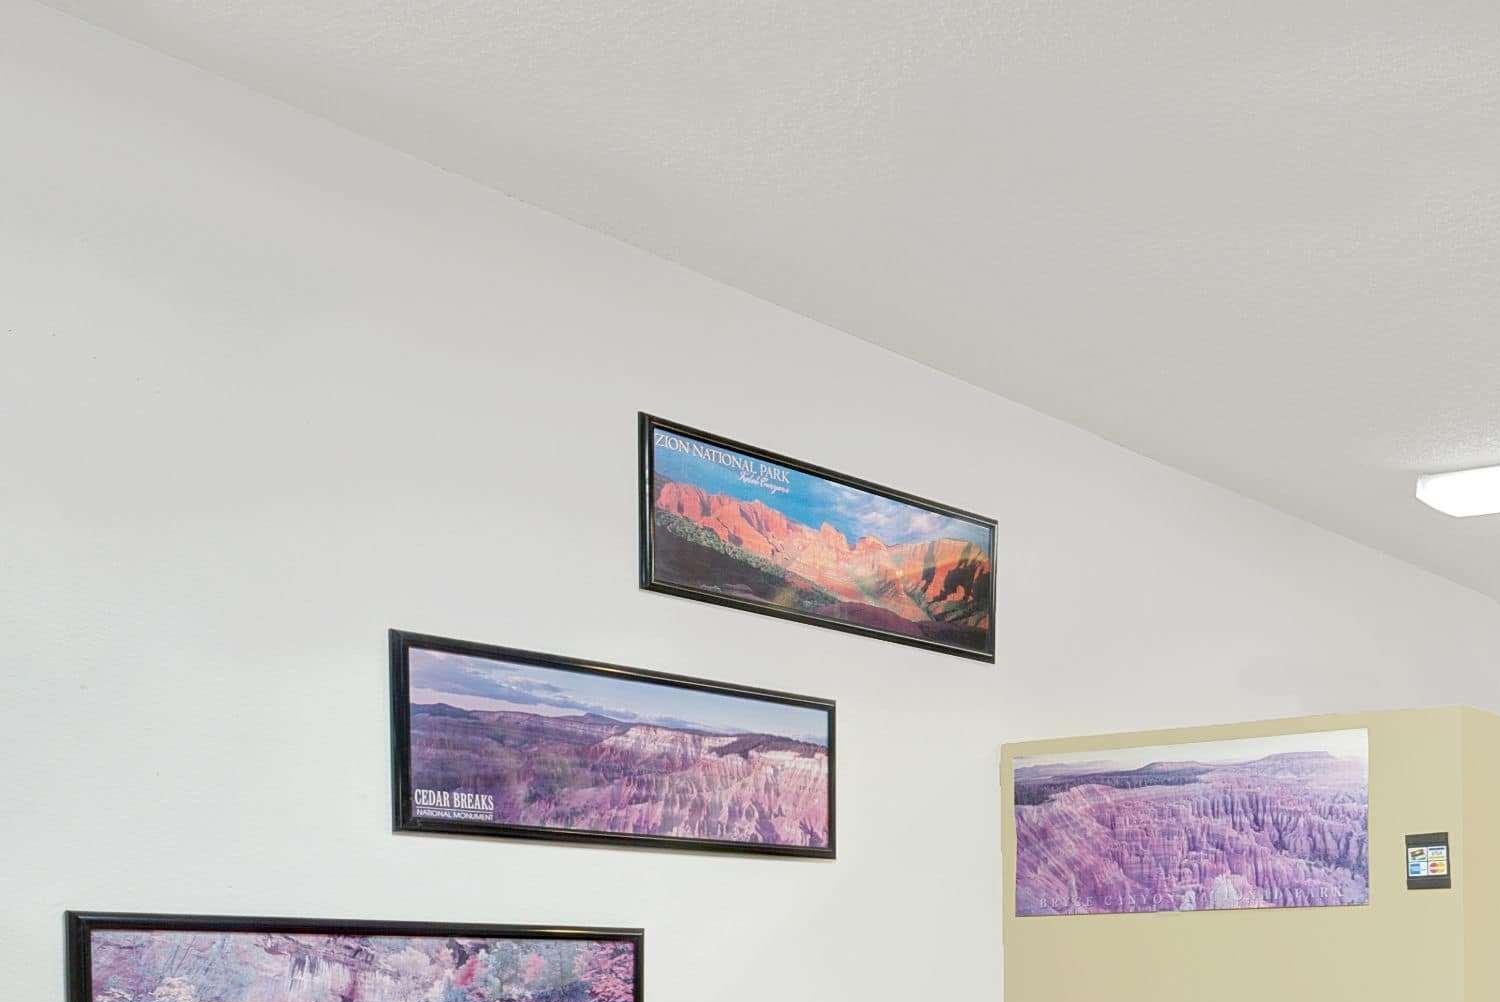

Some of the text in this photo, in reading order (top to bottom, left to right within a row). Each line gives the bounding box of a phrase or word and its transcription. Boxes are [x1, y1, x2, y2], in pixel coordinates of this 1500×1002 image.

[655, 433, 790, 484] ZION NATIONAL PARK
[414, 788, 494, 811] CEDAR BREAKS
[416, 808, 494, 821] NATIONAL MONUMENT
